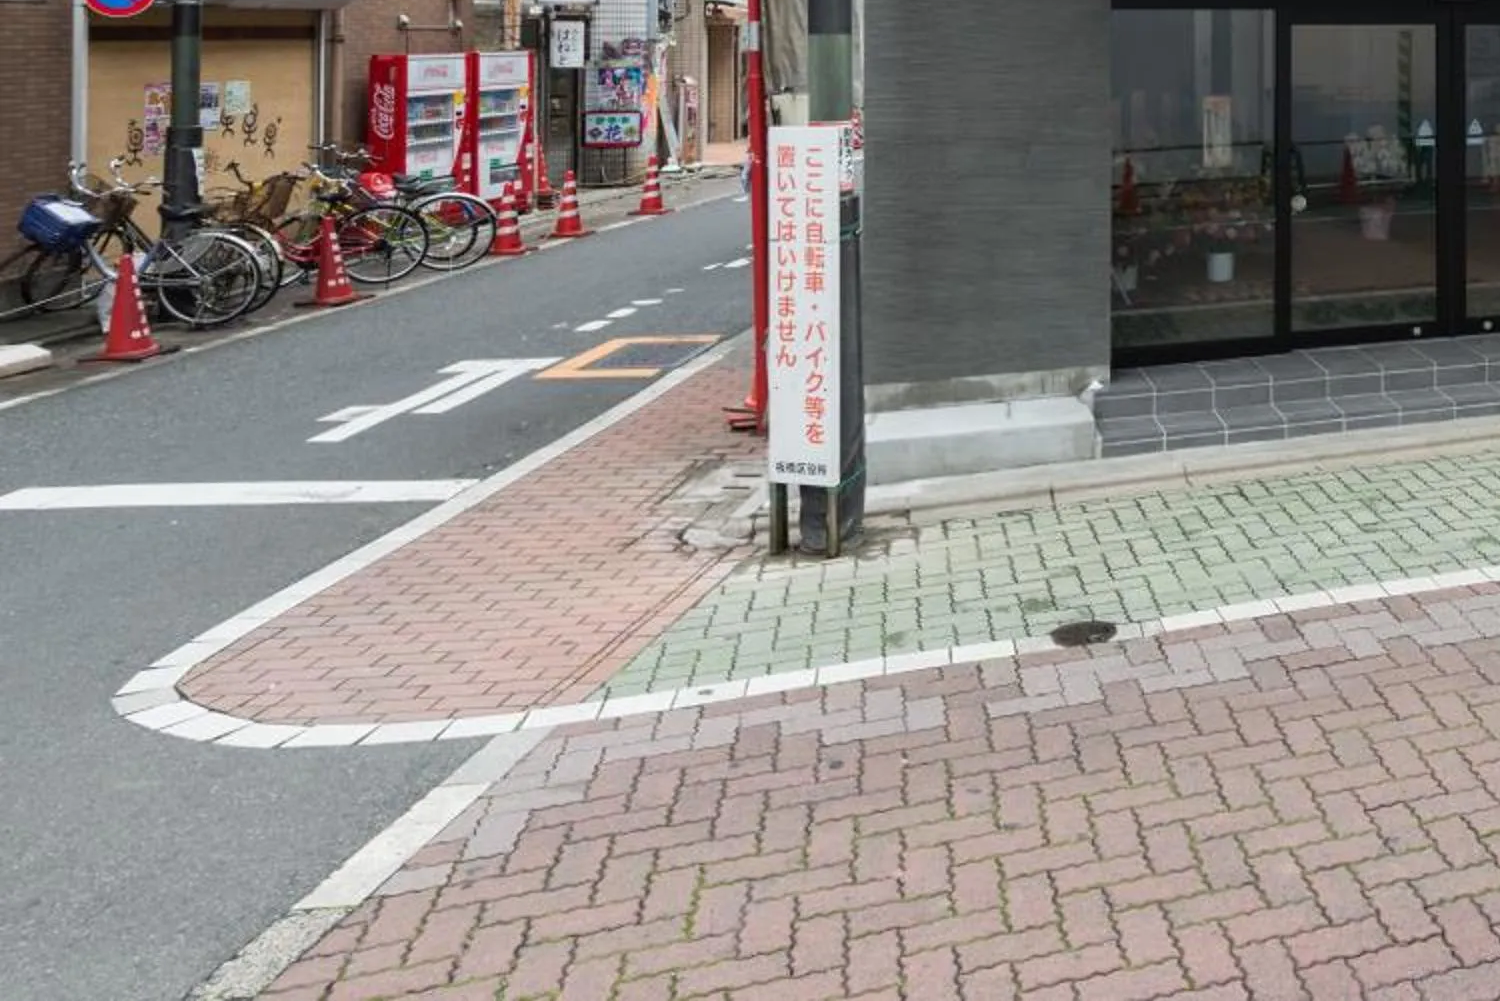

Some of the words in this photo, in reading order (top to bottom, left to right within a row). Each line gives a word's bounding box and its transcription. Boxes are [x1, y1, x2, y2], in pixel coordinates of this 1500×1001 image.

[370, 83, 395, 140] Coca-Cola
[775, 145, 798, 367] 置いてはいけません
[803, 145, 826, 444] ここに自転車・バイク等を
[775, 462, 827, 476] 板橋区役所
